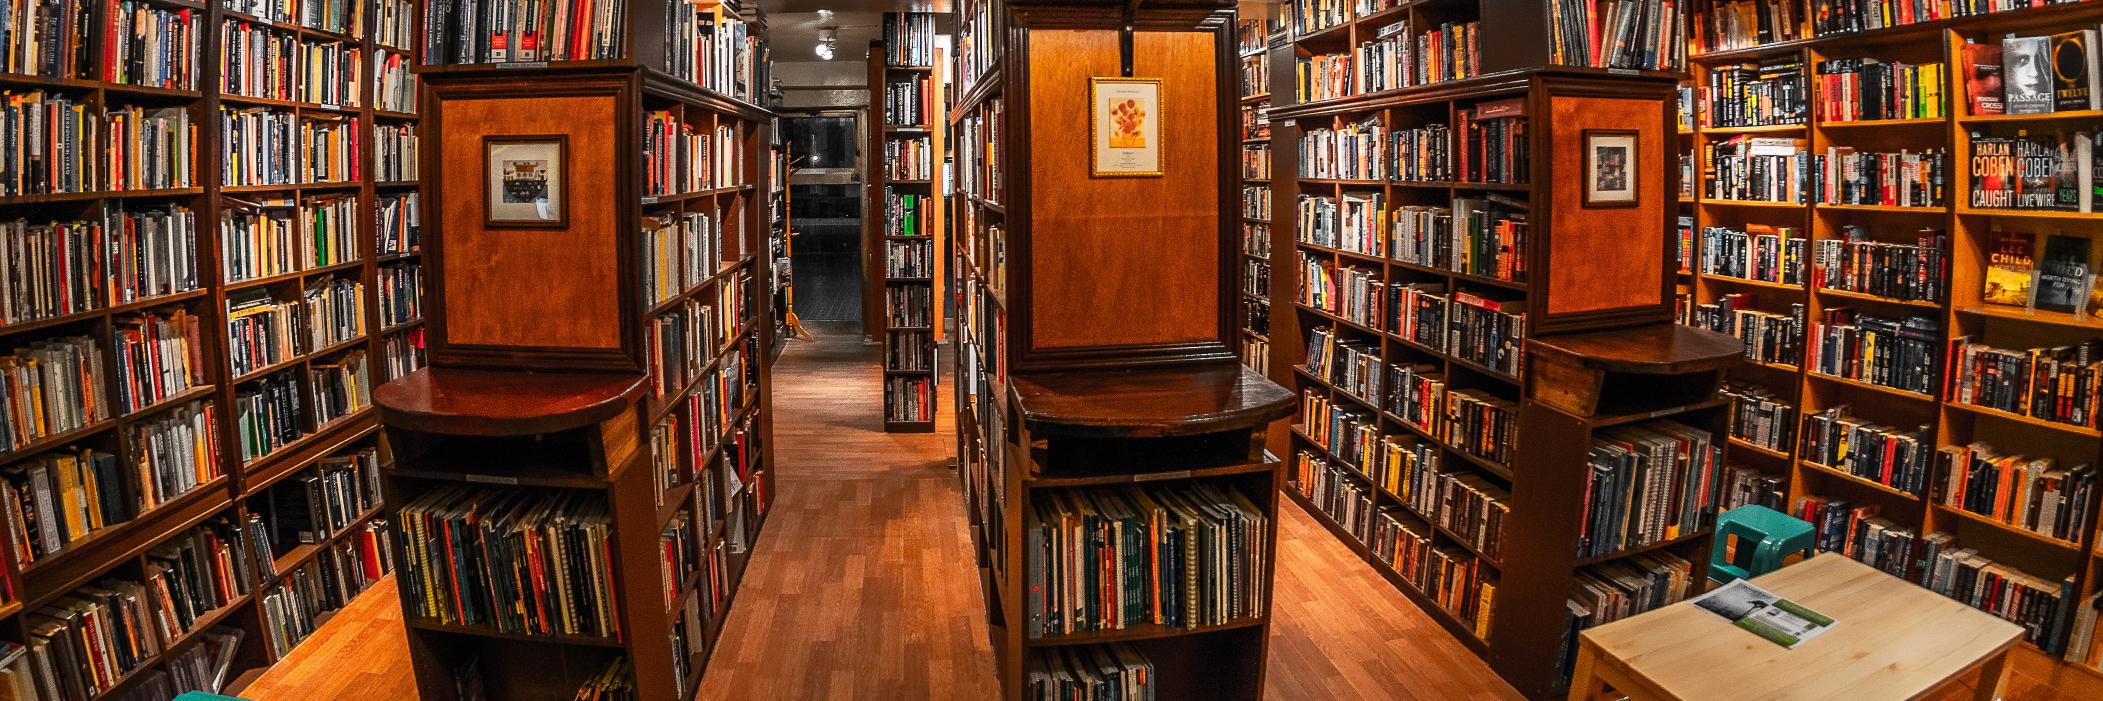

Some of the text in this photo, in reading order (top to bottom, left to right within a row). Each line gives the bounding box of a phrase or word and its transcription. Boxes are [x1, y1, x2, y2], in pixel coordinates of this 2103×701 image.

[2008, 93, 2051, 102] PASSAGE
[2058, 88, 2089, 98] TWELVE
[1976, 143, 2009, 156] HARLAN
[1972, 156, 2014, 177] COBEN
[2017, 157, 2054, 178] COBEN
[1972, 189, 2014, 207] CAUGHT
[2017, 193, 2056, 207] LIVE WIRE
[1991, 253, 2030, 265] CHILD
